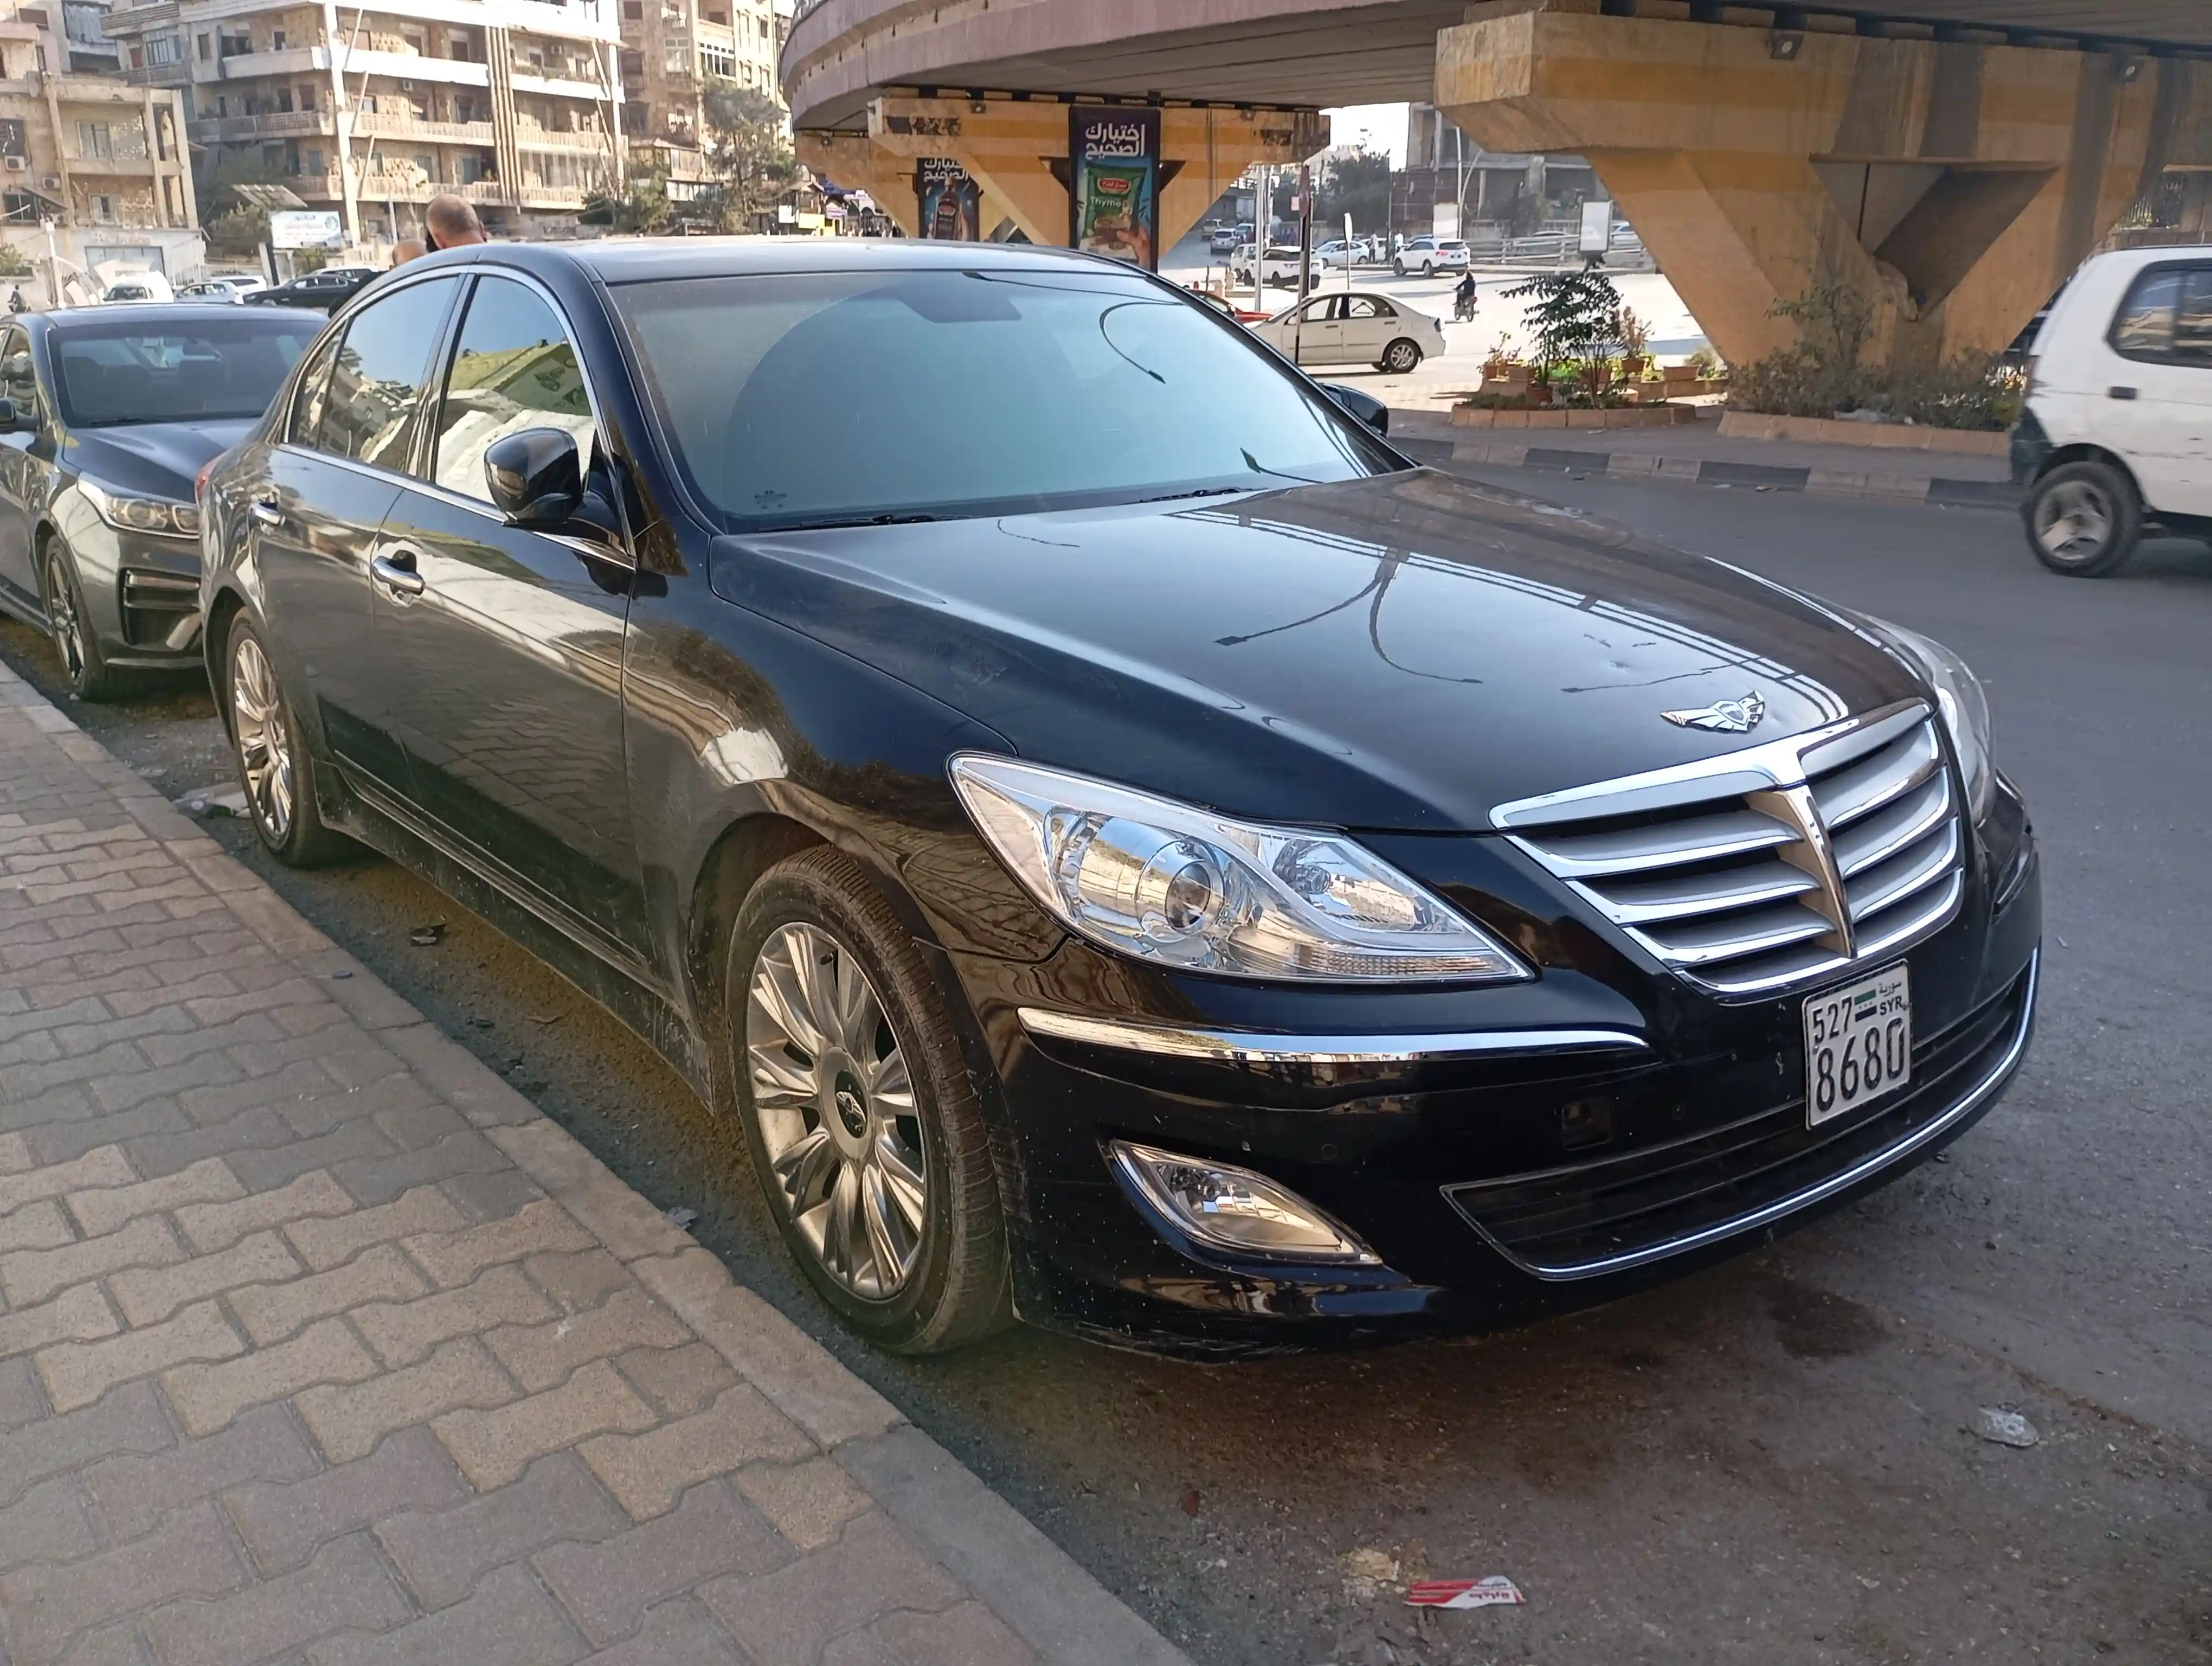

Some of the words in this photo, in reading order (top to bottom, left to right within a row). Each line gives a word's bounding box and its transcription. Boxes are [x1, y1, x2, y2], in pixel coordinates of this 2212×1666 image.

[1085, 123, 1146, 144] اختيارك
[1085, 140, 1145, 161] الصحيح
[1090, 196, 1122, 208] Thyme
[1878, 981, 1902, 997] سورية
[1879, 995, 1903, 1016] SYR
[1811, 995, 1853, 1046] 527
[1816, 1017, 1905, 1113] 8680
